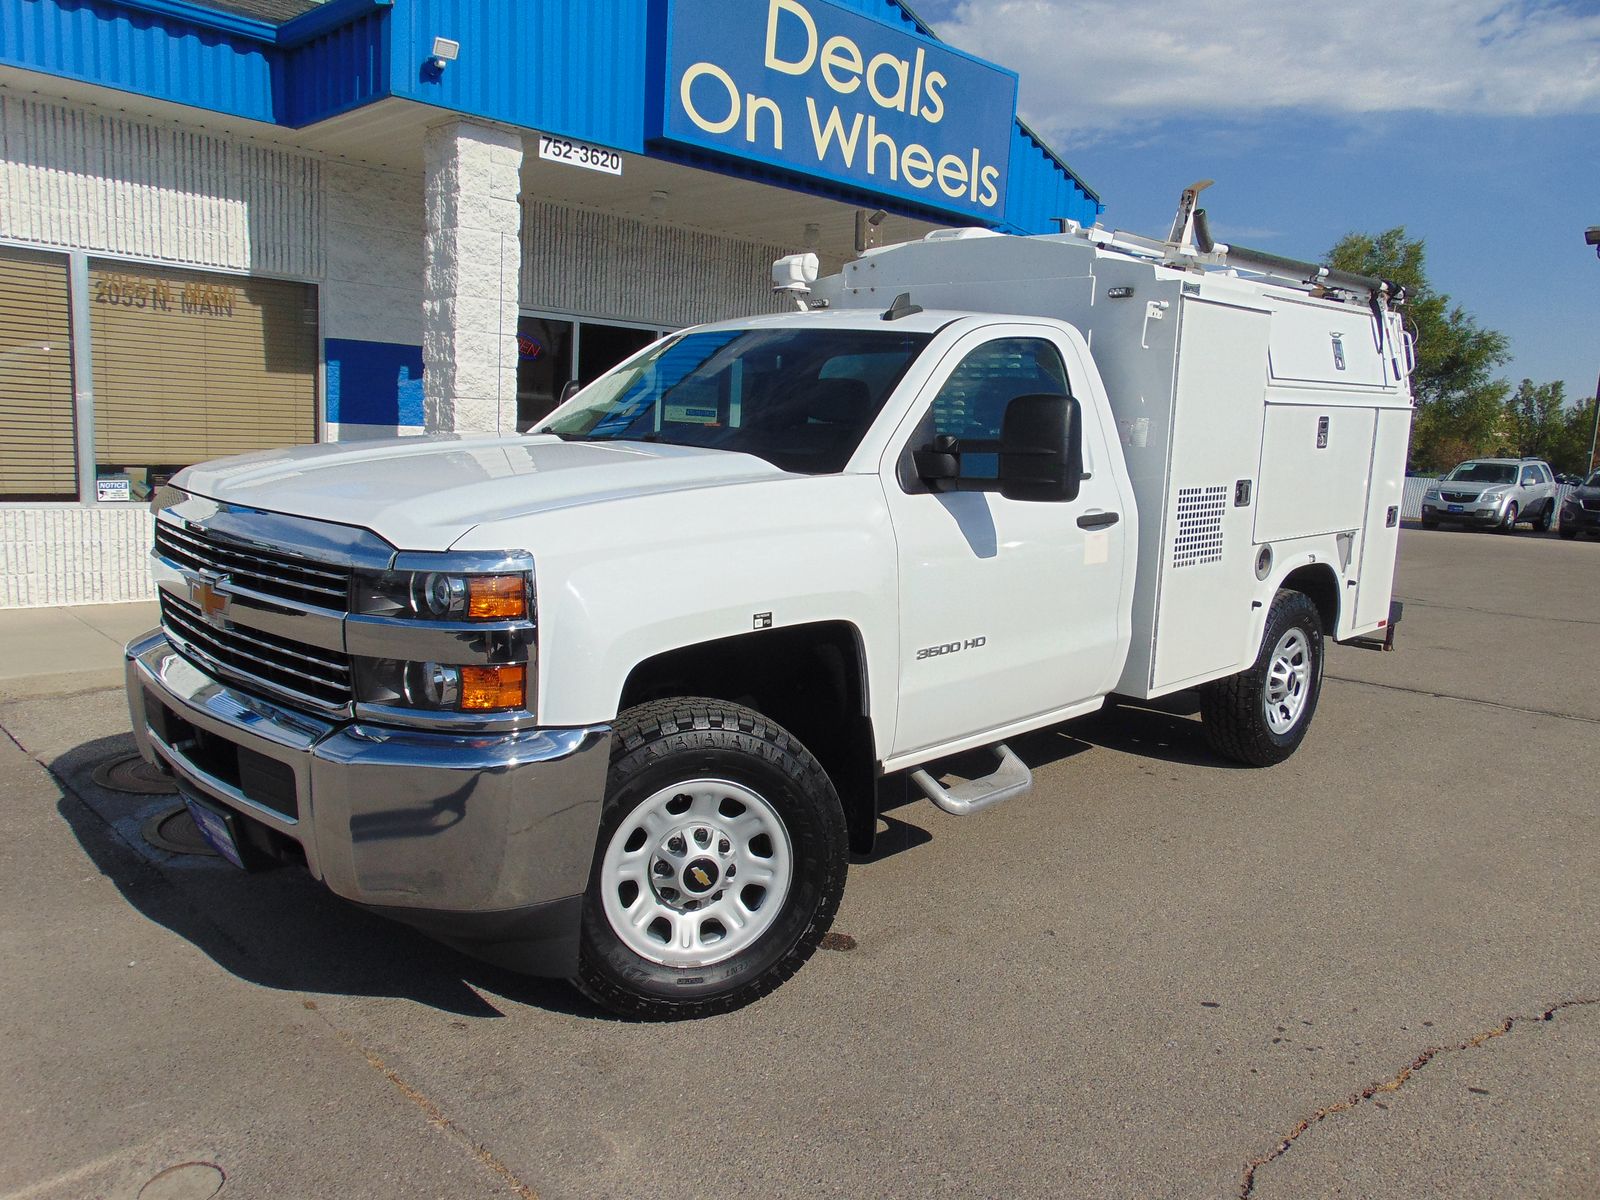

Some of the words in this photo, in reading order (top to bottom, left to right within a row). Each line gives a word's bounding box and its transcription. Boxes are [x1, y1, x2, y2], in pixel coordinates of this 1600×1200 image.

[764, 0, 947, 124] Deals
[542, 136, 620, 170] 752-3620
[680, 62, 783, 150] On
[805, 96, 1000, 207] Wheels
[181, 280, 236, 318] MAIN
[963, 636, 986, 650] HD
